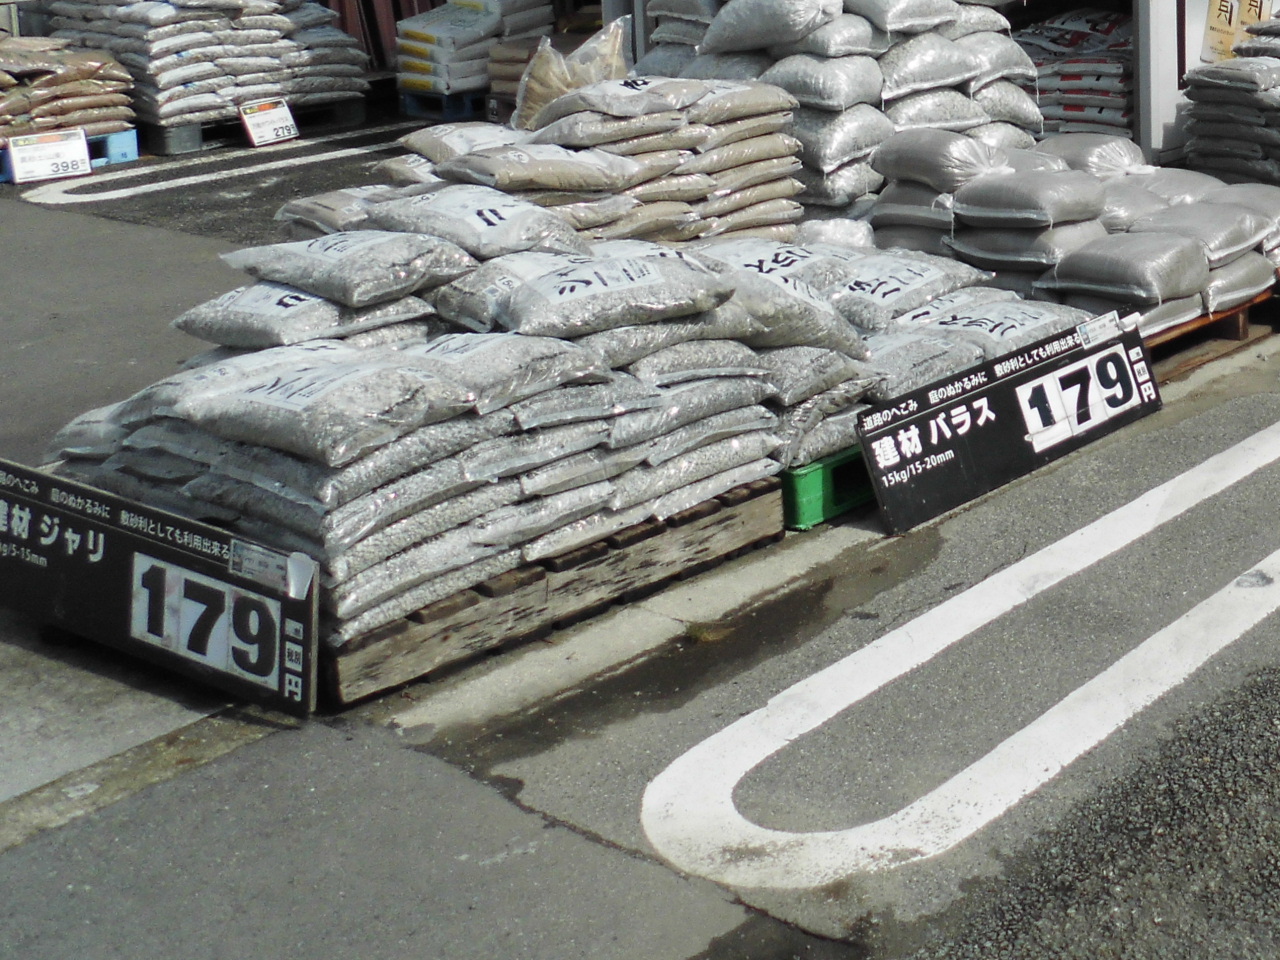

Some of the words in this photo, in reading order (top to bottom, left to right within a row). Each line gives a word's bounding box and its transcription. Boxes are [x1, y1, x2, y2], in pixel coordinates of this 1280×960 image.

[273, 125, 292, 137] 279
[51, 160, 80, 173] 398
[862, 400, 918, 431] 道路のへこみ
[928, 372, 988, 404] 庭のぬかるみに
[994, 333, 1082, 378] 敷砂利としても利用出来る
[1027, 352, 1135, 428] 179
[1140, 381, 1157, 403] 円
[871, 425, 921, 469] 建材
[929, 396, 996, 445] バラス
[882, 449, 955, 488] 15kg/15-20mm
[40, 514, 105, 562] ジャリ
[51, 488, 110, 518] 庭のぬかるみに
[119, 510, 230, 560] 敷砂利としても利用出来る
[0, 542, 48, 568] g/5-15mm
[142, 564, 277, 677] 179
[285, 673, 303, 702] 円
